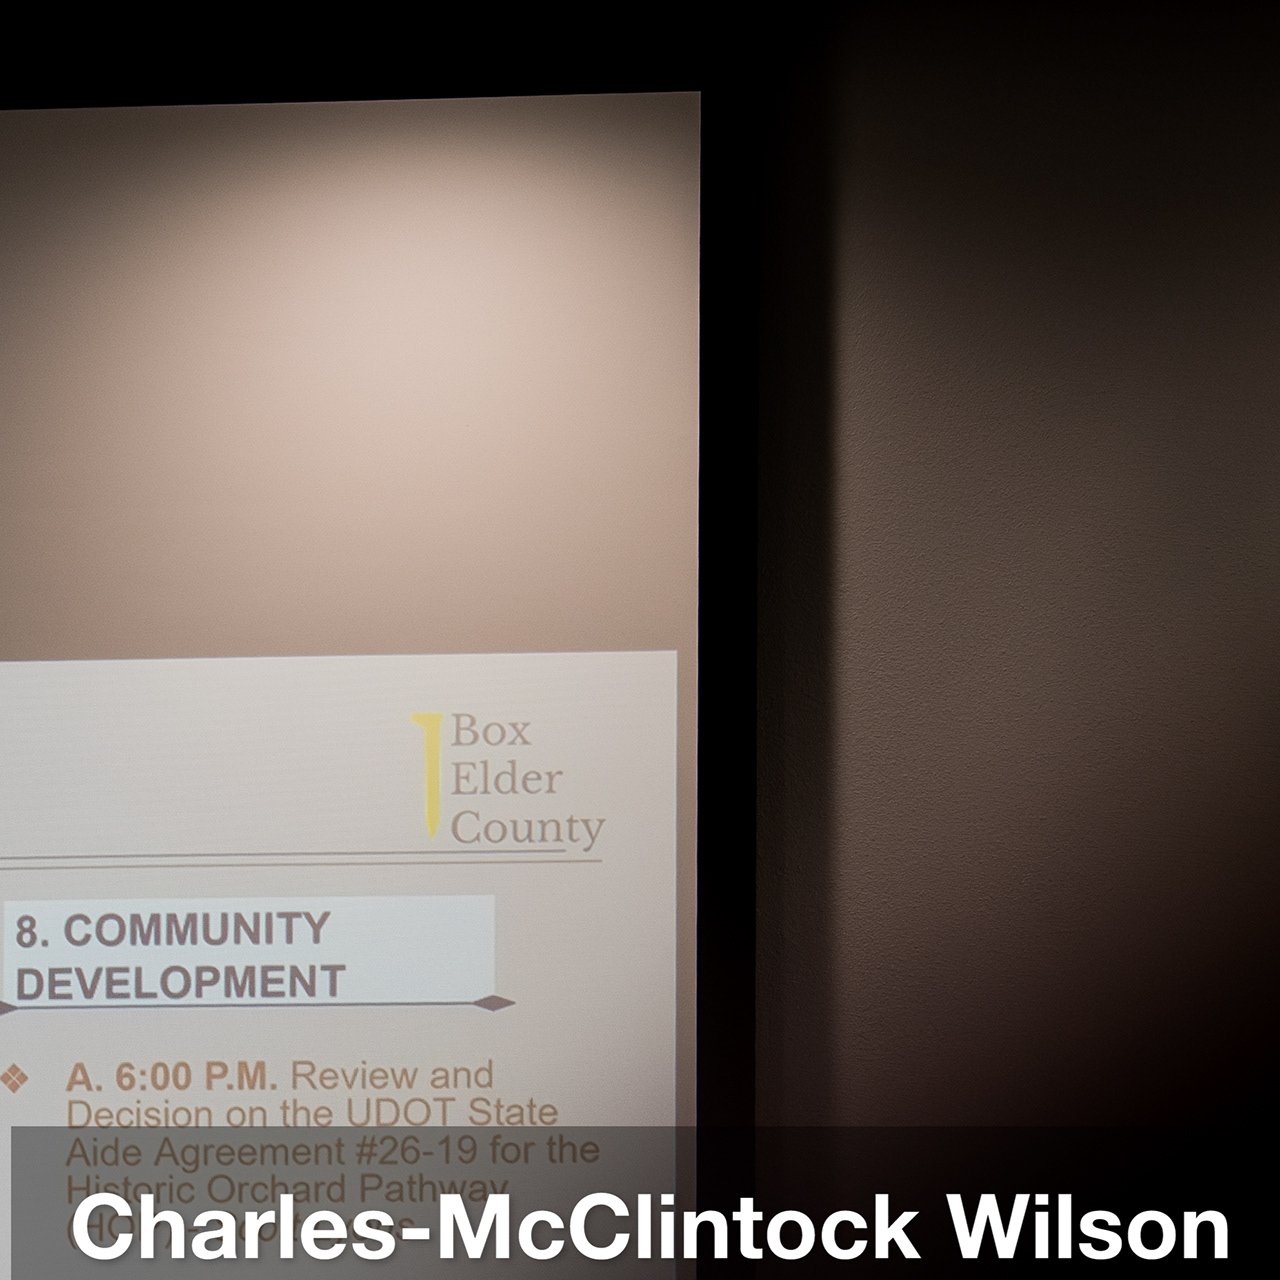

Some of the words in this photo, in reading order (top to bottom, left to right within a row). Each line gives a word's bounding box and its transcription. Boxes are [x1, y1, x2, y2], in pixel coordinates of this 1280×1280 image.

[451, 713, 532, 747] Box
[451, 759, 564, 795] Elder
[450, 810, 606, 851] County
[16, 914, 49, 949] 8.
[64, 911, 331, 947] COMMUNITY
[16, 964, 346, 1001] DEVELOPMENT
[65, 1062, 103, 1092] A.
[115, 1061, 192, 1092] 6:00
[205, 1060, 278, 1091] P.M.
[291, 1060, 419, 1091] Review
[430, 1058, 494, 1090] and
[67, 1099, 213, 1130] Decision
[225, 1106, 268, 1128] on
[280, 1099, 333, 1128] the
[347, 1098, 452, 1127] UDOT
[467, 1097, 559, 1126] State
[65, 1136, 142, 1167] Aide
[153, 1136, 346, 1174] Agreement
[356, 1134, 478, 1166] #26-19
[489, 1134, 536, 1165] for
[546, 1134, 601, 1164] the
[67, 1175, 194, 1203] Historic
[207, 1174, 346, 1203] Orchard
